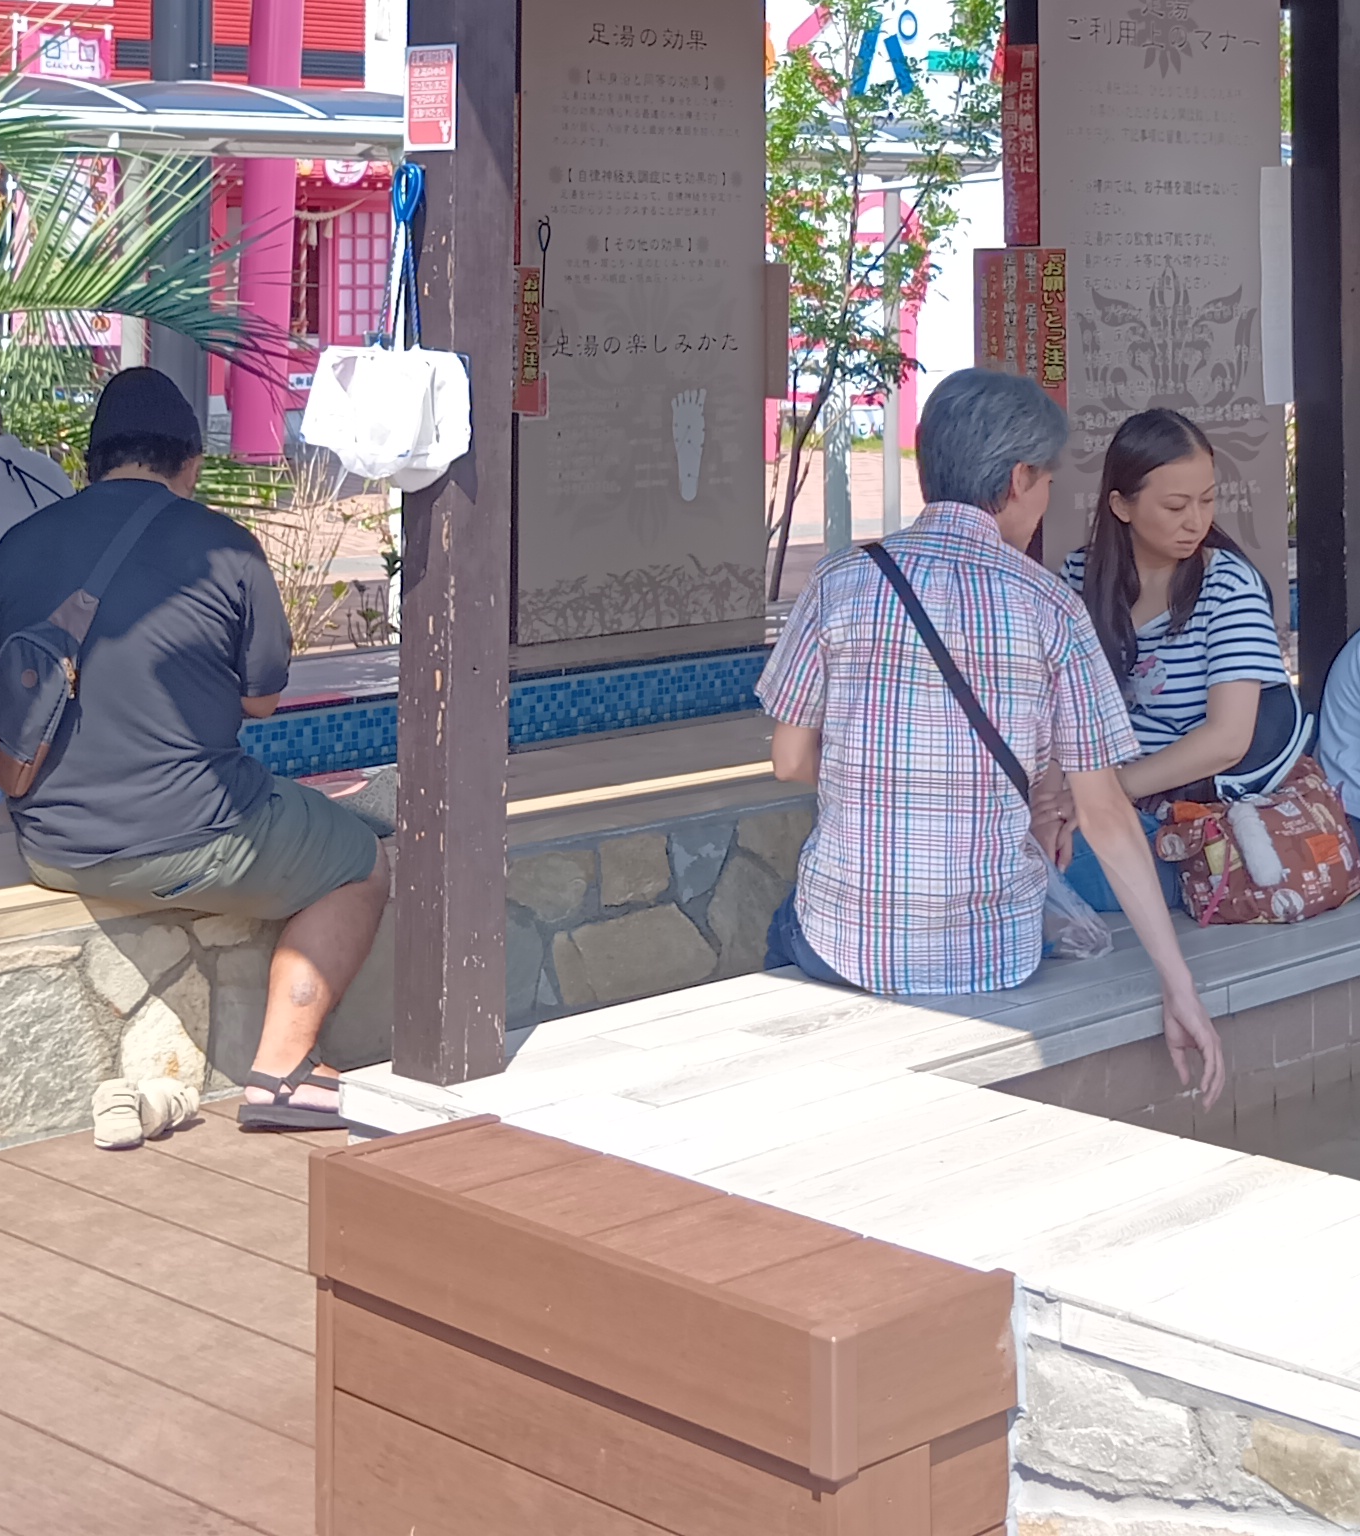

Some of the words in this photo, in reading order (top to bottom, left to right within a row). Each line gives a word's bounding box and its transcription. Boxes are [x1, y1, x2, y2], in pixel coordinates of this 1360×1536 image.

[588, 22, 708, 52] 足湯の効果
[1067, 16, 1261, 53] ご利用上のマナー
[551, 331, 740, 359] 足湯の楽しみかた
